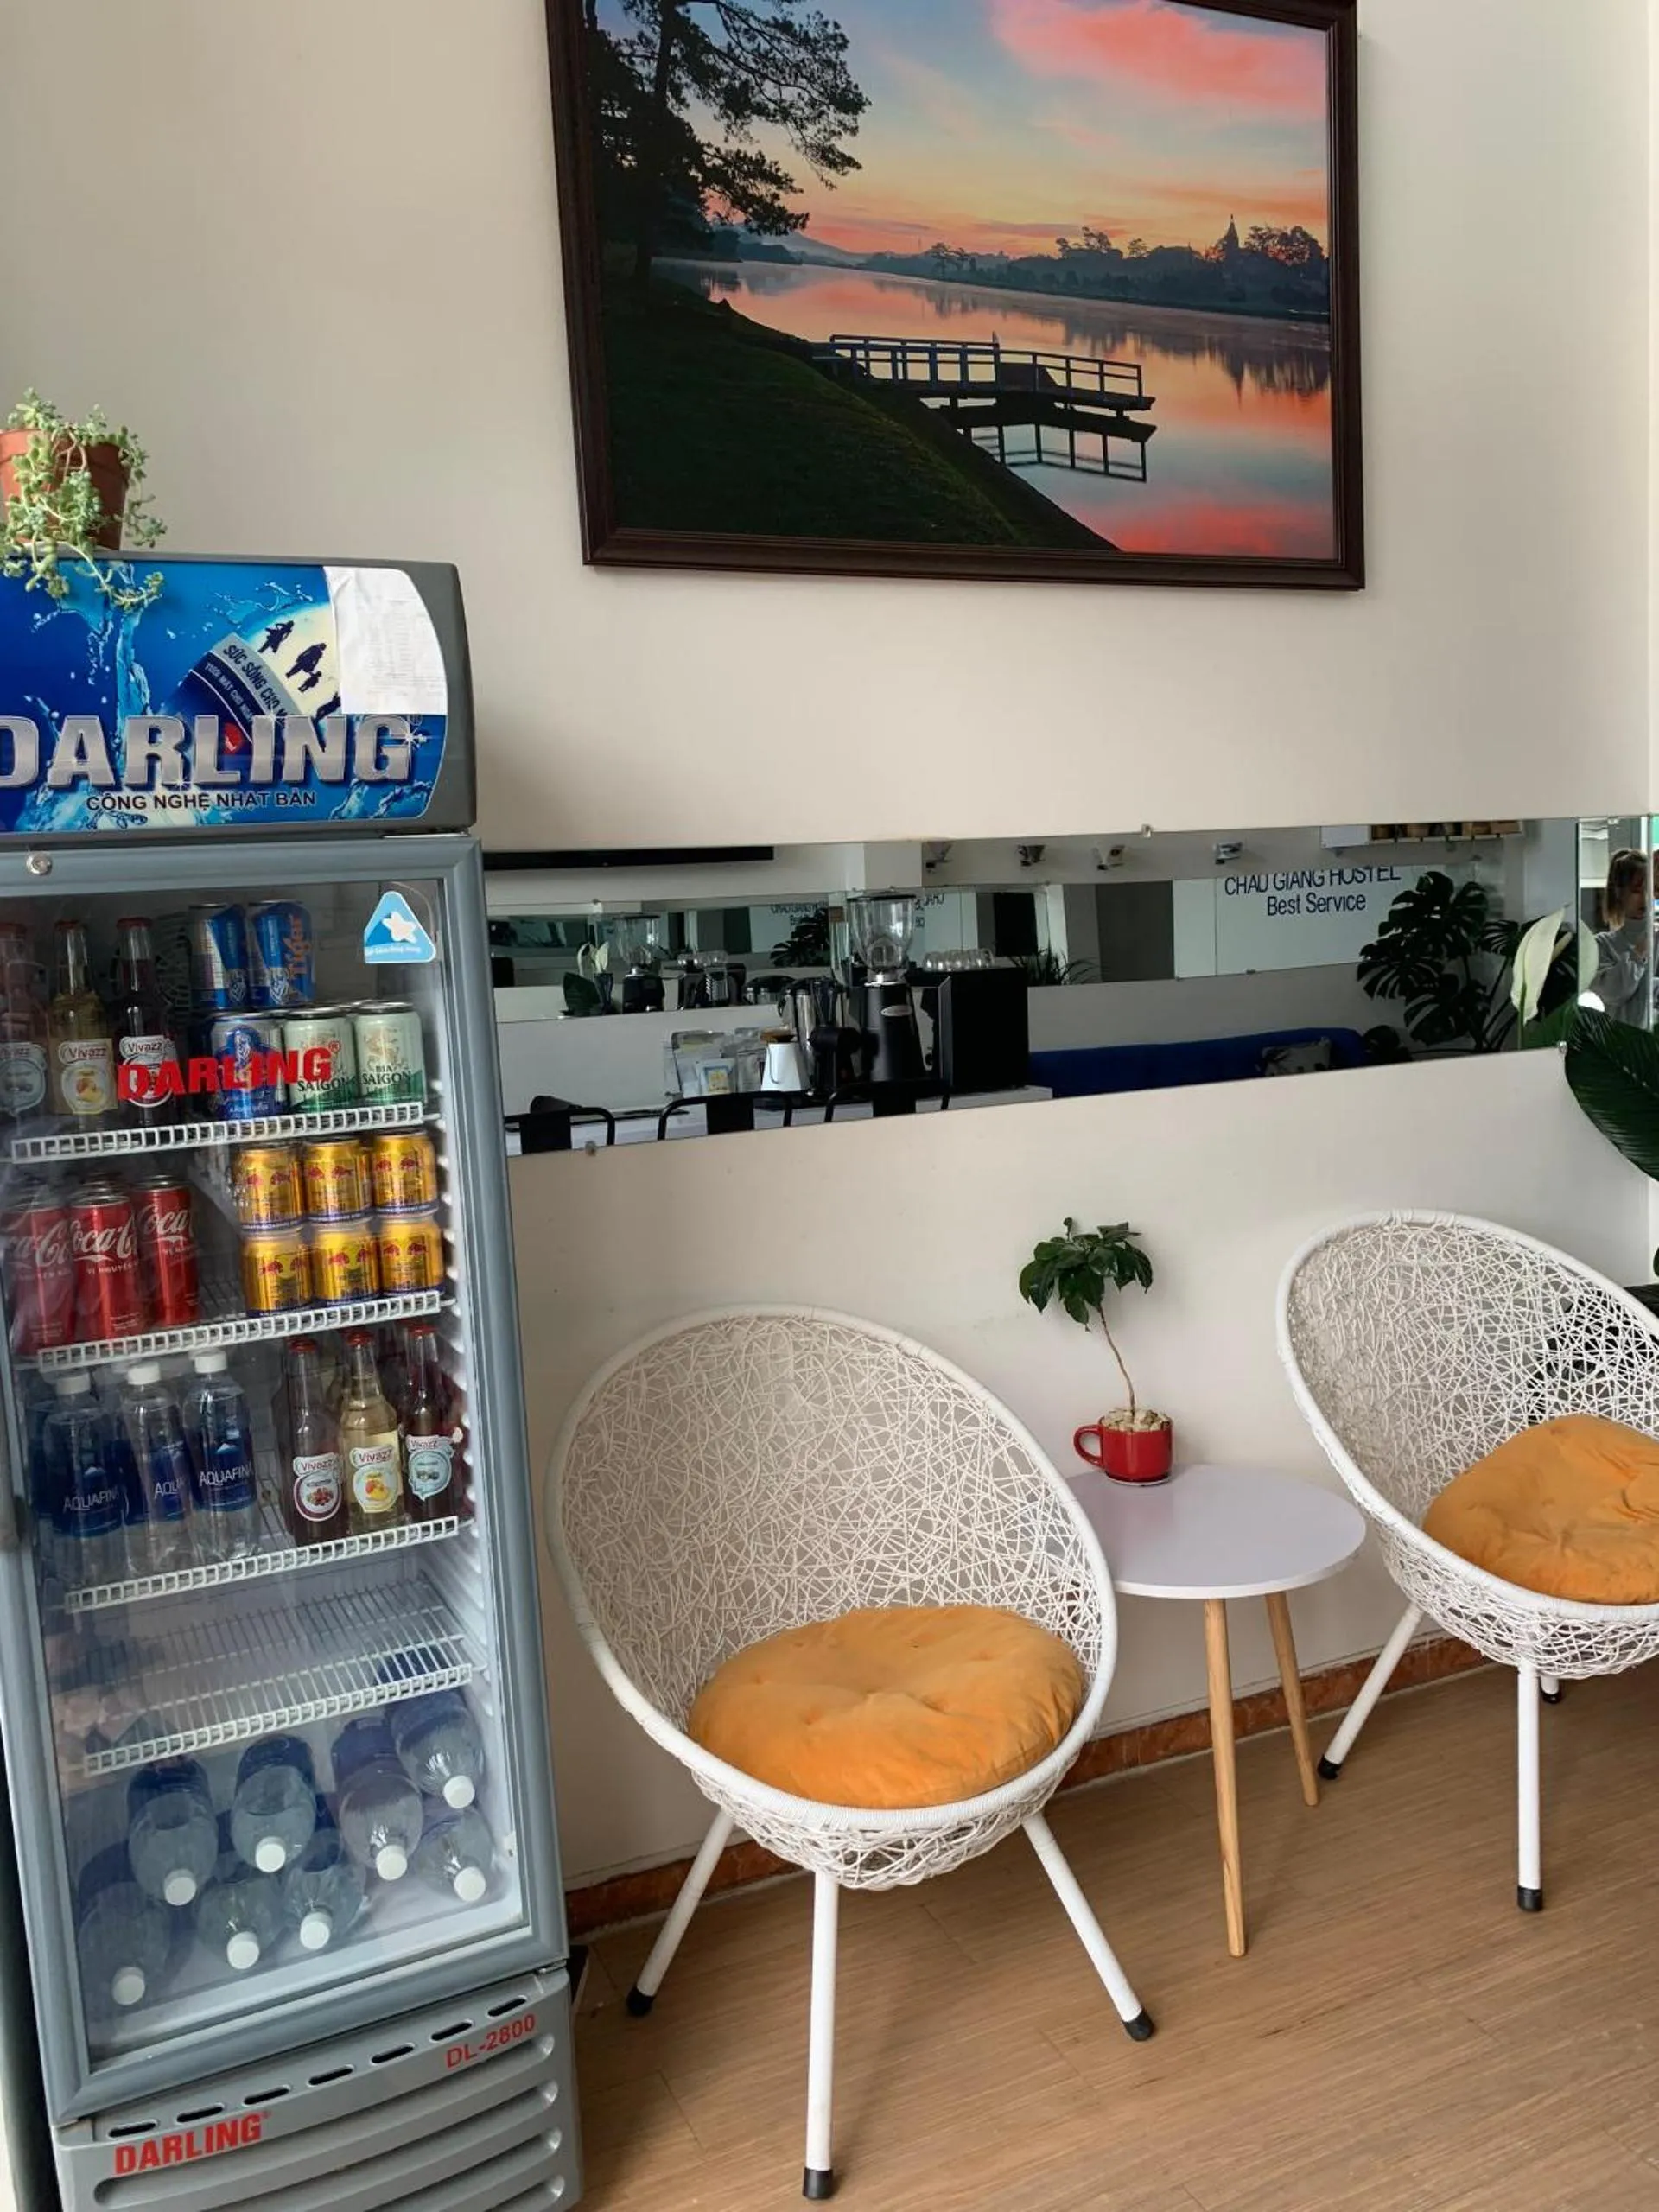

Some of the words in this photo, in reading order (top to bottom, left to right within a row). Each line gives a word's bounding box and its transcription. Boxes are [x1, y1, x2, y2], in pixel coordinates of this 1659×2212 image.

[86, 792, 147, 810] CÔNG
[1267, 895, 1301, 917] Best
[1306, 892, 1367, 914] Service
[68, 1046, 107, 1060] Vivazz
[127, 1041, 162, 1053] Vivazz
[118, 1045, 332, 1102] DARLING
[362, 1071, 413, 1086] SAIGON
[359, 1449, 392, 1463] Vivazz
[302, 1459, 334, 1471] Vivazz
[445, 2012, 537, 2069] DL-2800
[113, 2112, 264, 2175] DARLING
